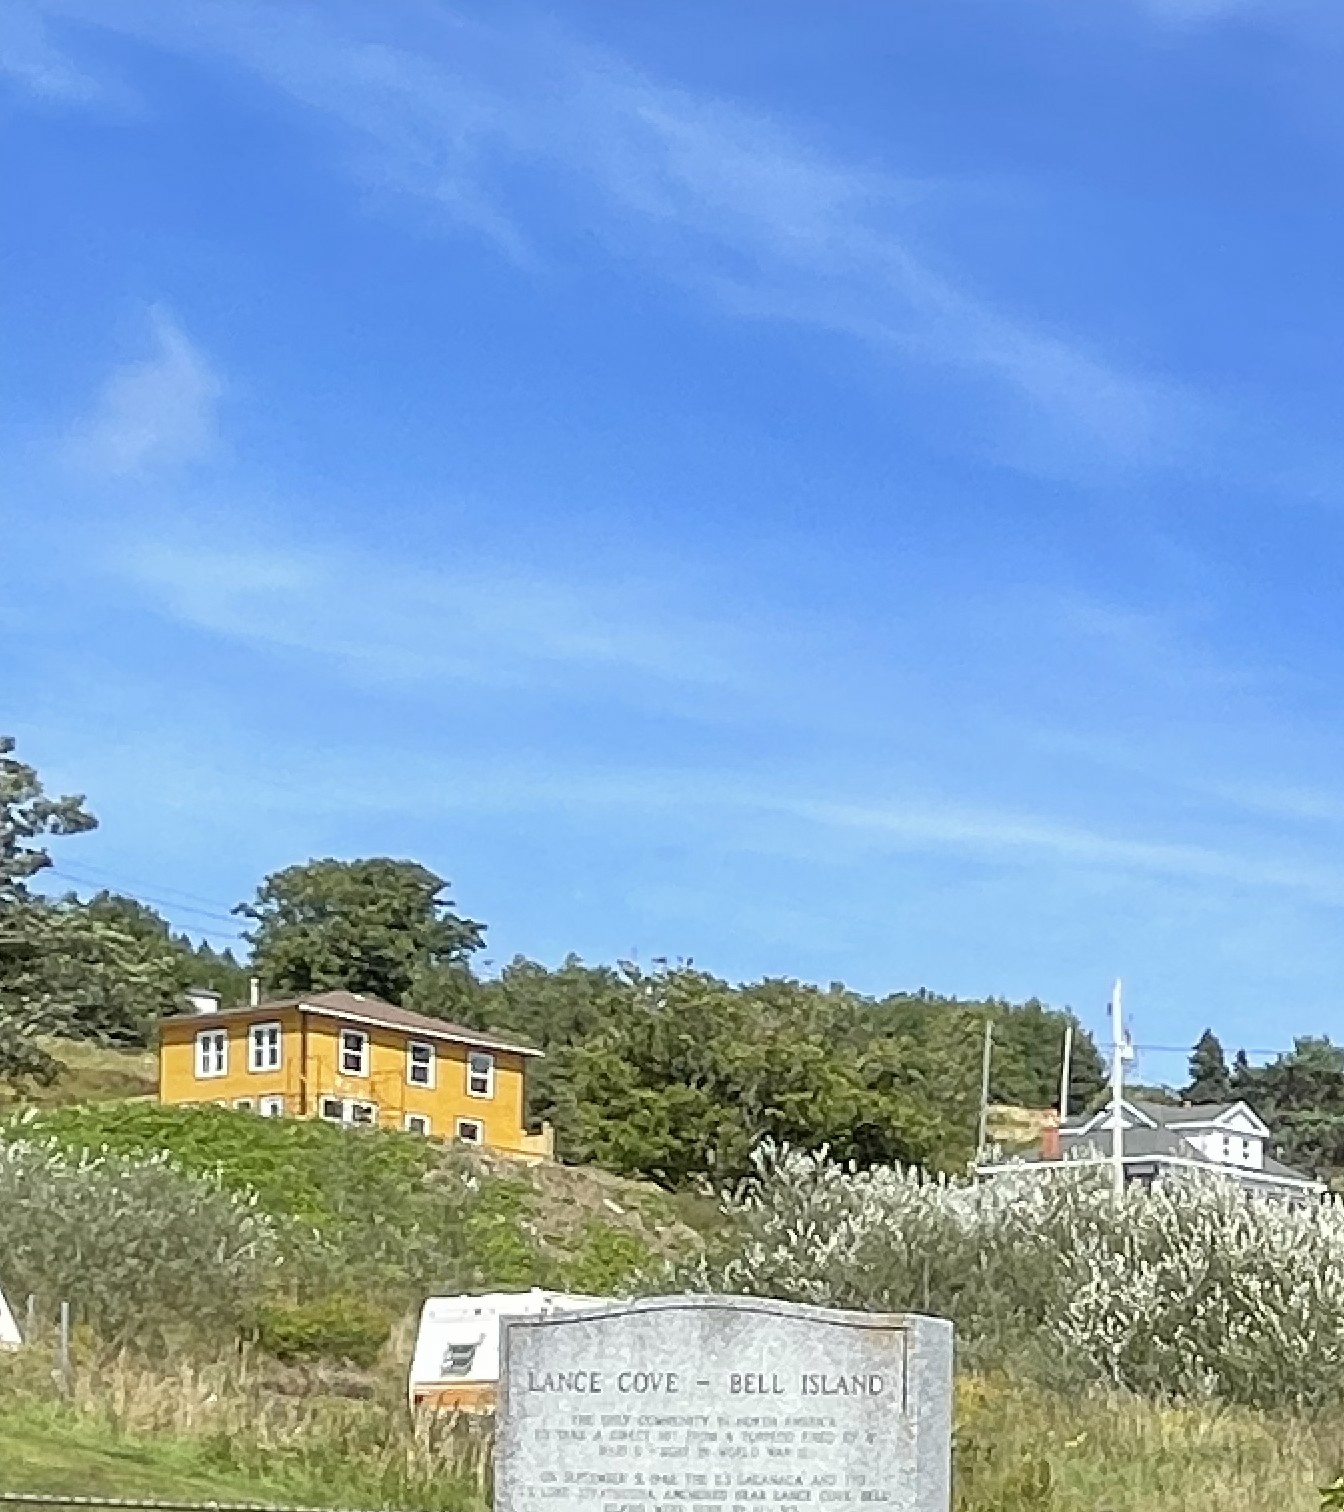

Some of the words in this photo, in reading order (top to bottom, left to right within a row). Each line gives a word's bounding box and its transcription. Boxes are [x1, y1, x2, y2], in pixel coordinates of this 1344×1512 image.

[528, 1371, 602, 1393] LANCE
[617, 1371, 679, 1393] COVE
[730, 1373, 785, 1395] BELL
[801, 1374, 883, 1396] ISLAND
